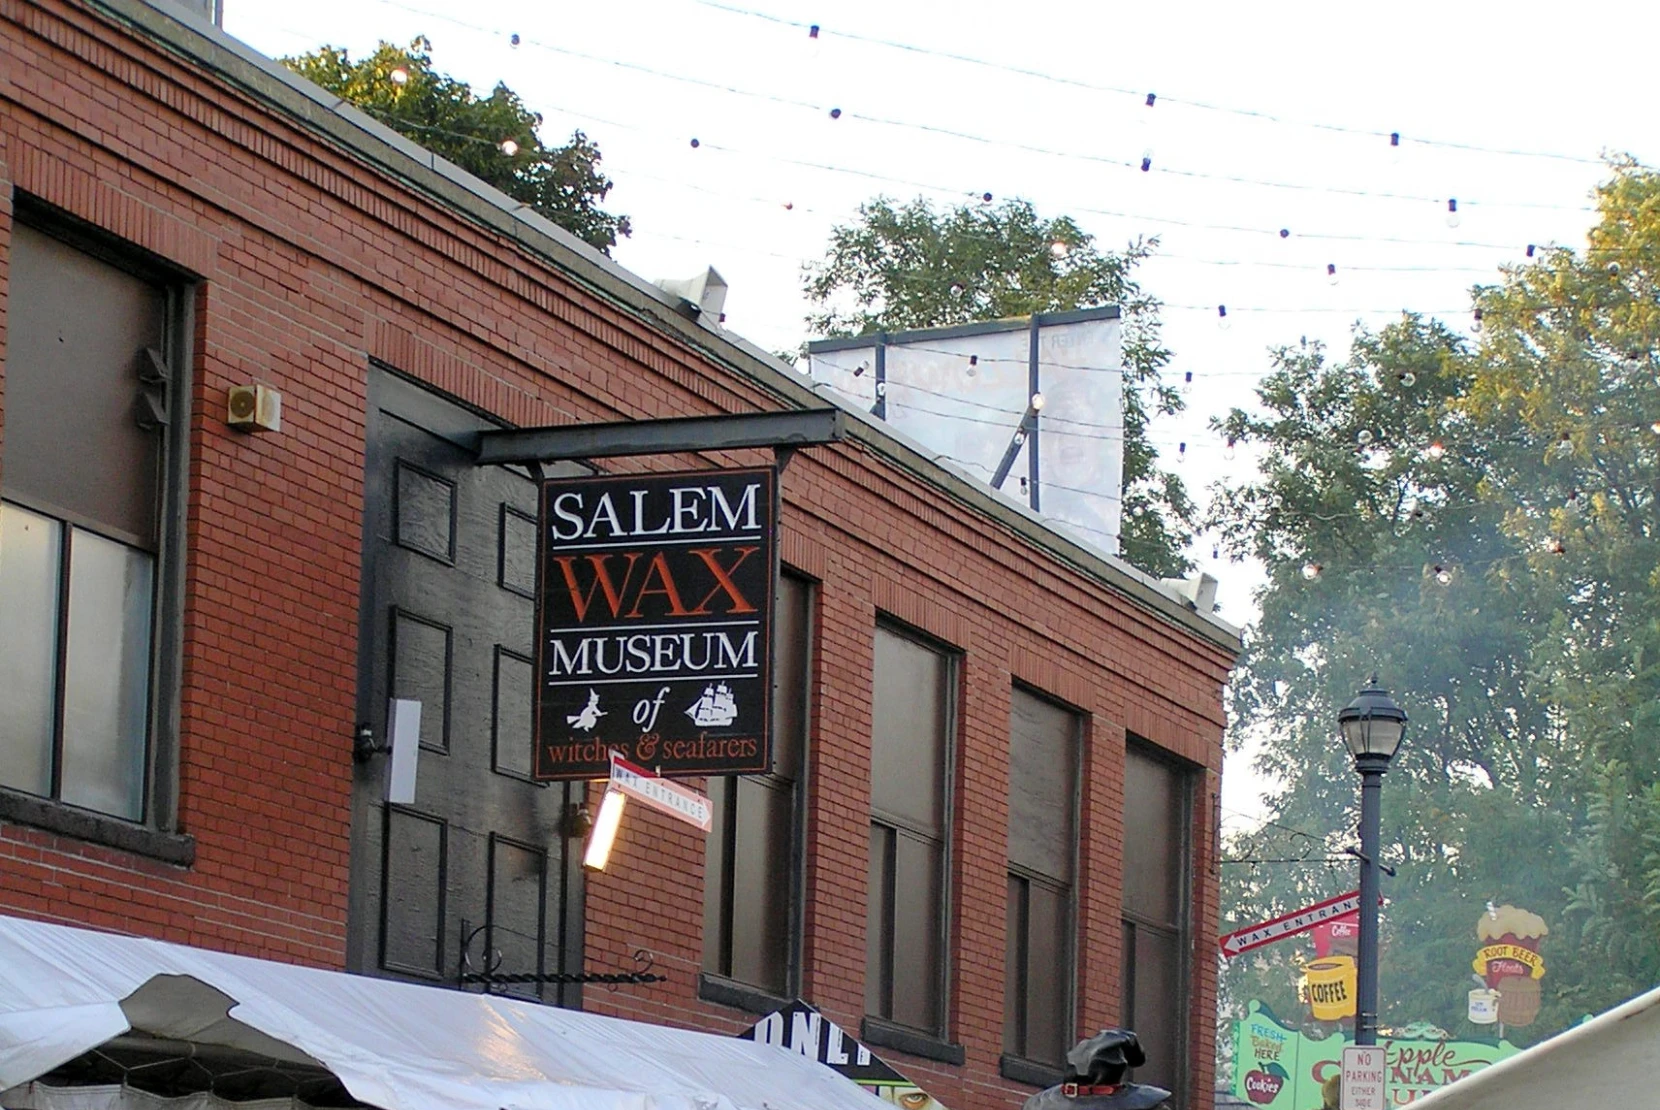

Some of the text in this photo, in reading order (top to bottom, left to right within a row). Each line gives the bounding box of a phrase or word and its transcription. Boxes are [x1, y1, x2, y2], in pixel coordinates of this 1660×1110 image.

[552, 484, 762, 541] SALEM
[553, 546, 760, 623] WAX
[549, 631, 759, 676] MUSEUM
[632, 686, 671, 733] of
[635, 733, 660, 762] &
[663, 731, 758, 759] seafarers
[644, 780, 703, 819] ENTRANCE
[1236, 900, 1361, 948] WAX ENTRAN
[1484, 945, 1538, 966] ROOT BEER
[1311, 980, 1348, 1003] COFFEE
[1251, 1023, 1288, 1042] FRESH
[1254, 1048, 1281, 1062] HERE
[1357, 1053, 1372, 1066] NO
[1246, 1075, 1279, 1094] Cookies
[1345, 1070, 1383, 1084] PARKING
[1351, 1086, 1376, 1096] EITHER
